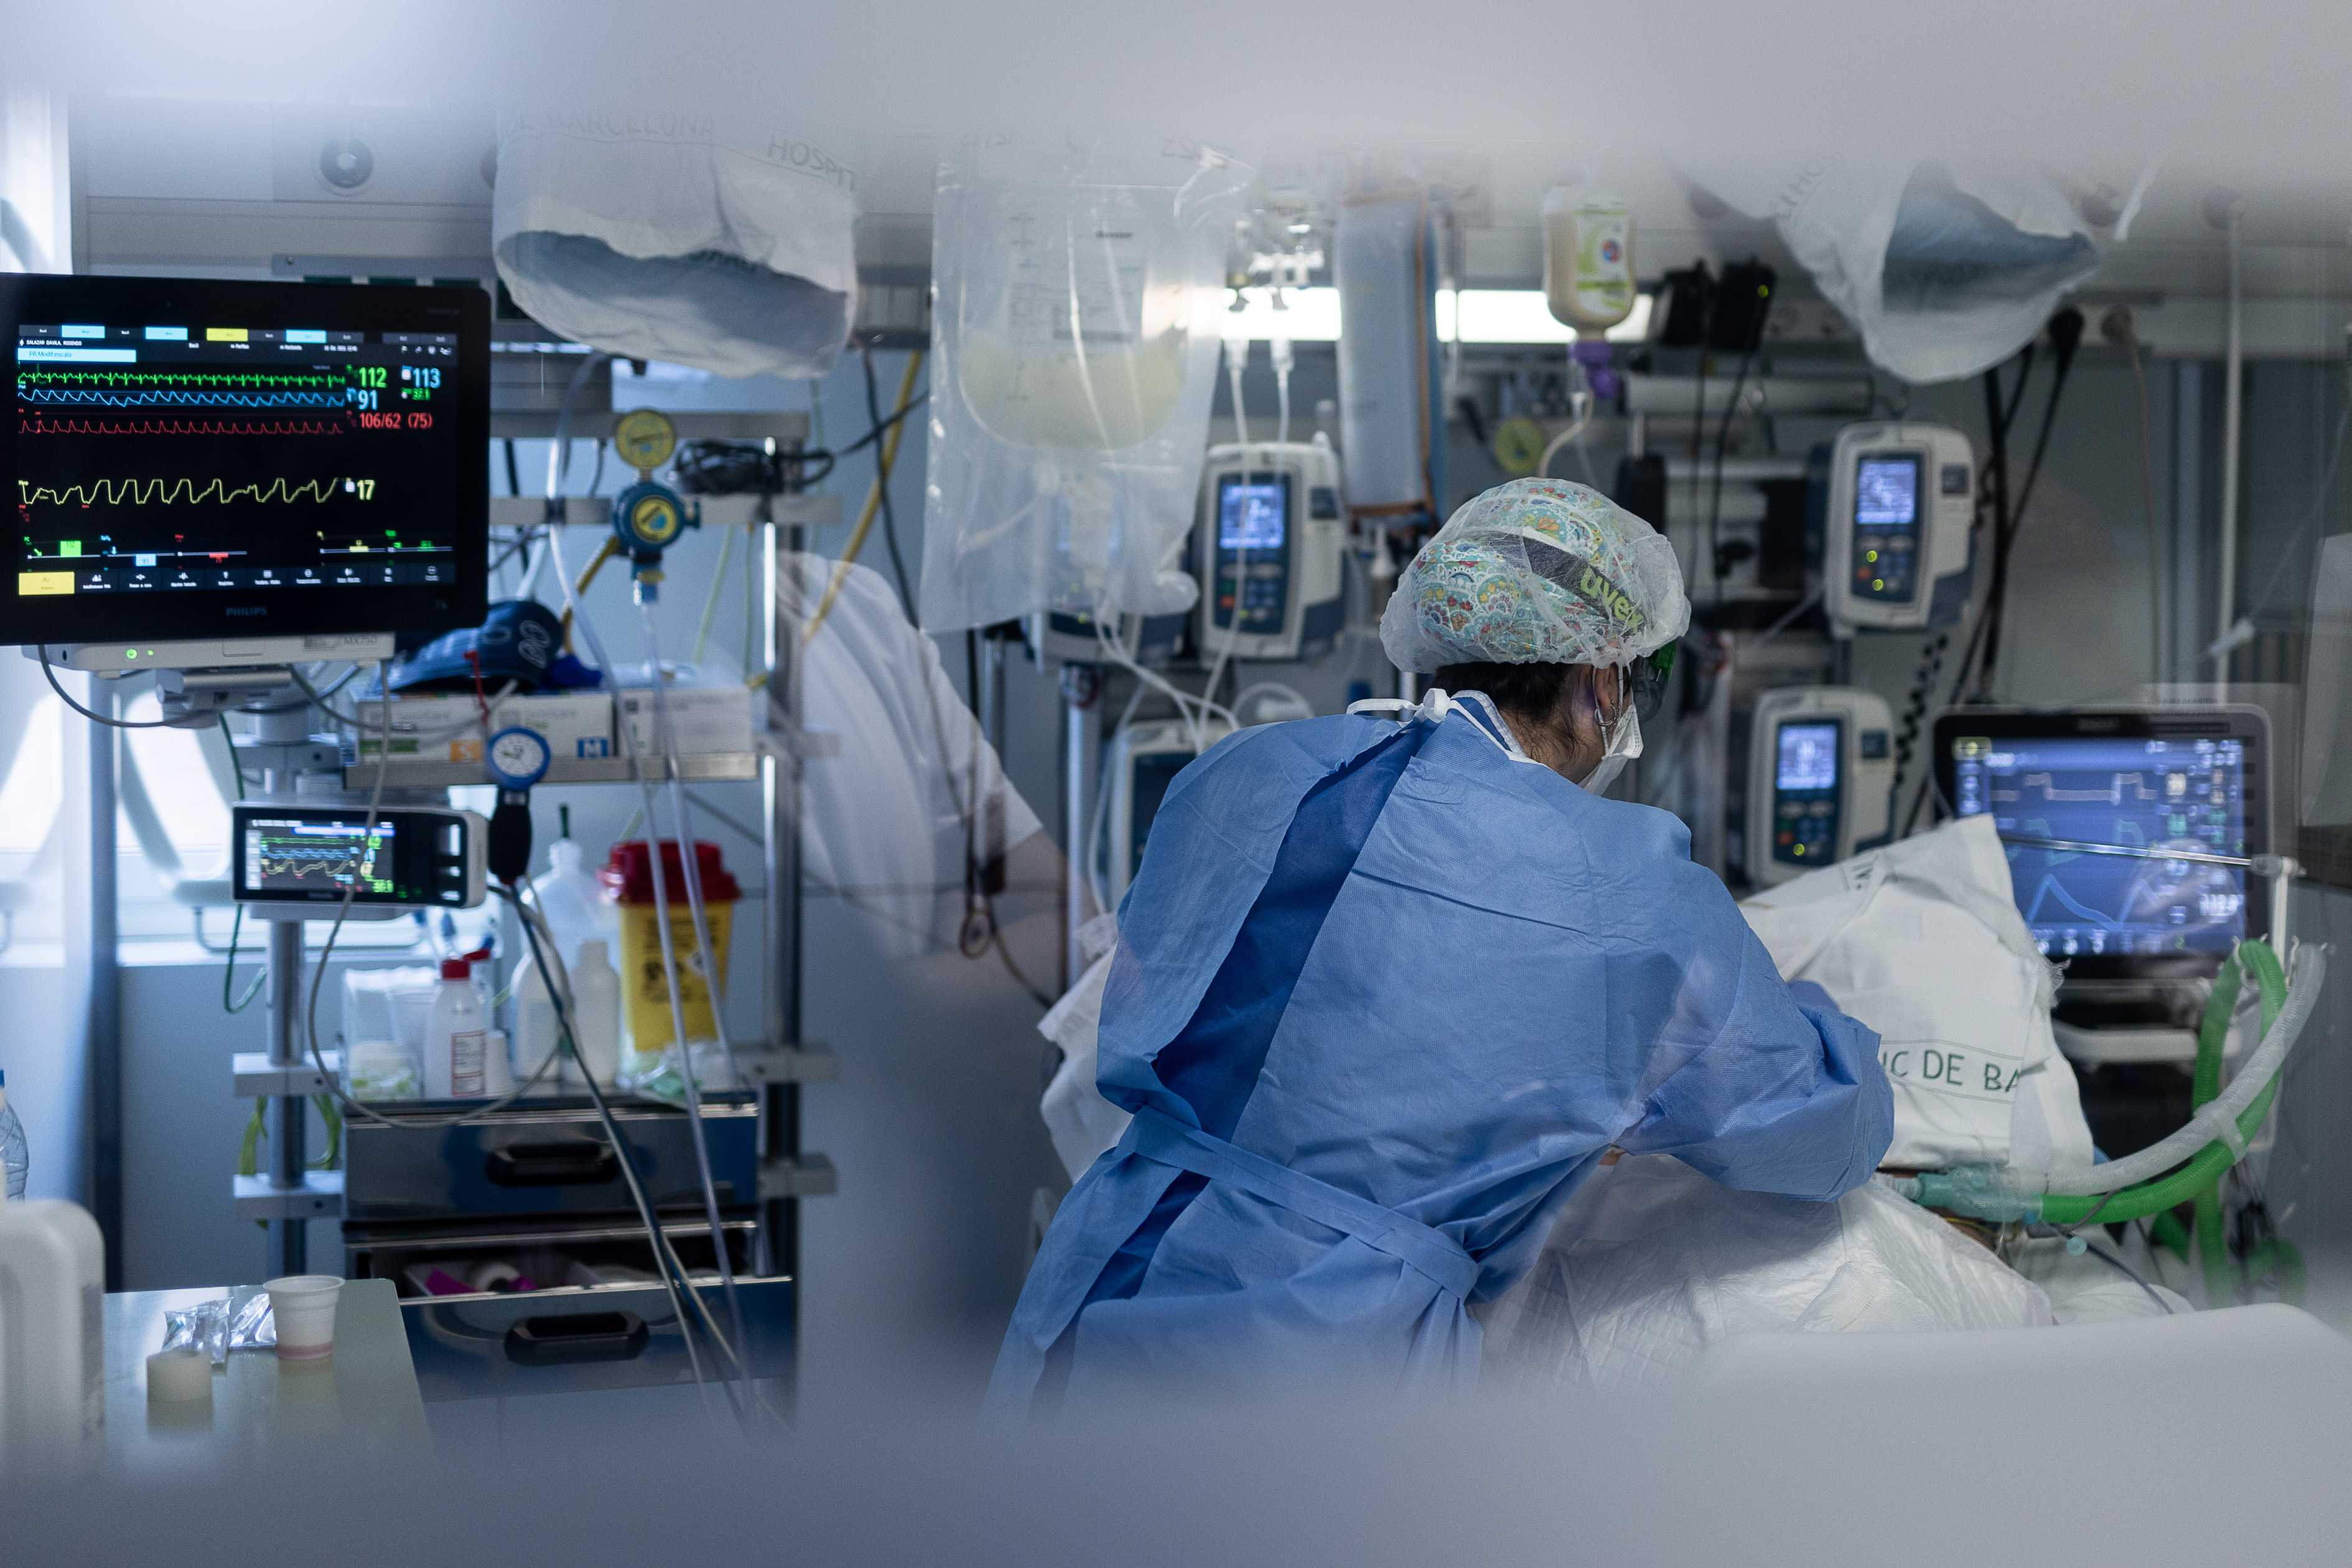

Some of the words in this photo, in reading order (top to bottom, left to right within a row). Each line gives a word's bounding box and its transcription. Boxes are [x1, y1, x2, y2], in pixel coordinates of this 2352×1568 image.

[358, 366, 387, 388] 112
[413, 368, 441, 388] 113
[358, 389, 378, 409] 91
[359, 412, 401, 429] 106/62
[408, 412, 434, 429] (75)
[357, 479, 375, 500] 17
[1580, 567, 1645, 635] uvex
[225, 607, 268, 616] PHILIPS
[1923, 1048, 1966, 1086] DE
